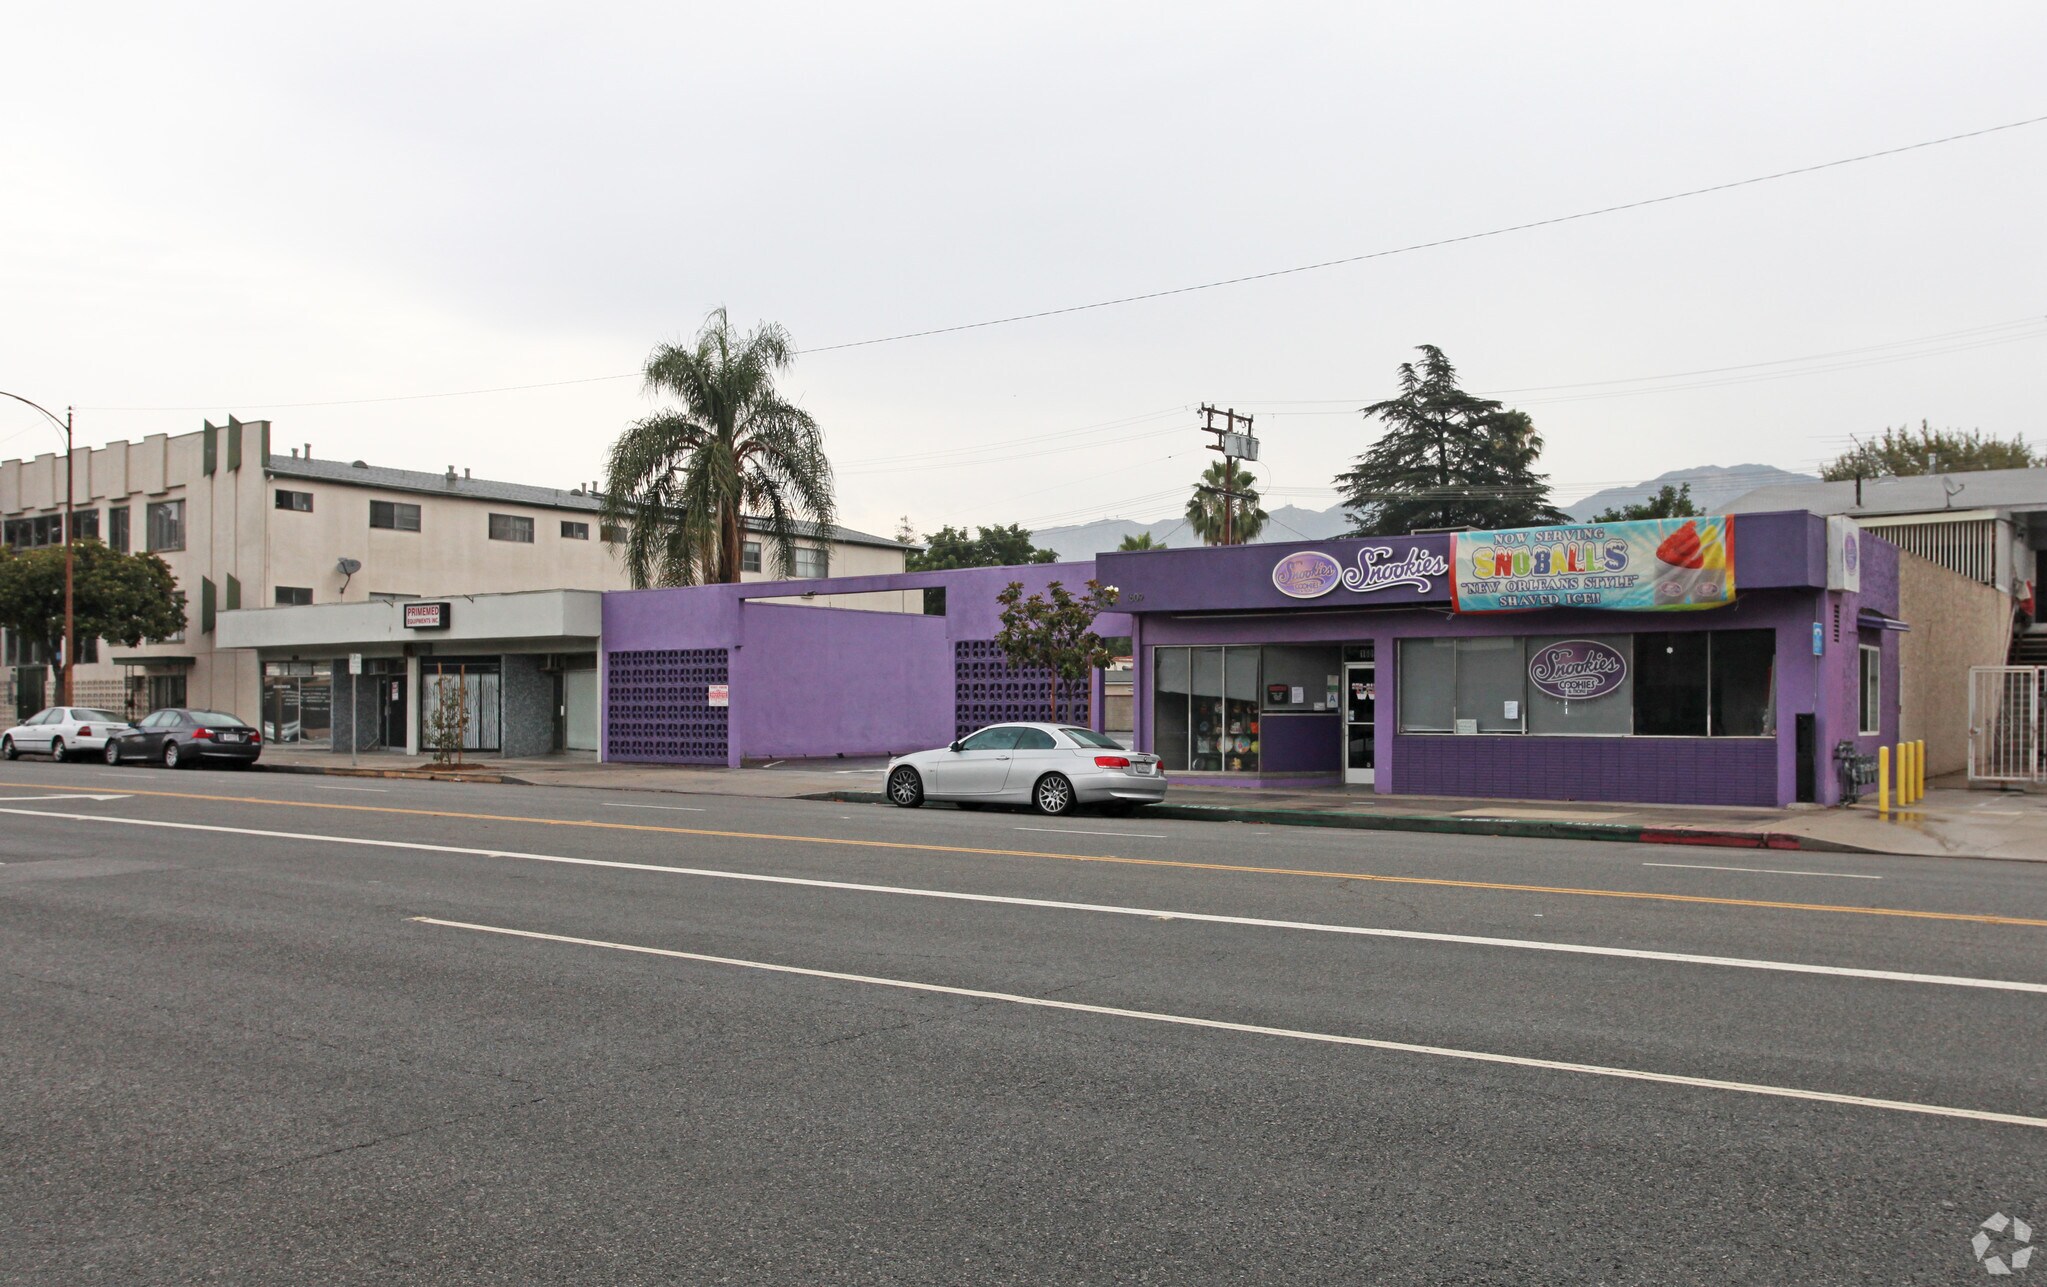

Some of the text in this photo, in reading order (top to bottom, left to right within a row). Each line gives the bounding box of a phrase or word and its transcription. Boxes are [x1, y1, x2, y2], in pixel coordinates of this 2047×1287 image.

[1494, 527, 1604, 545] NOW SERVING
[1277, 560, 1335, 586] Snookies
[1341, 546, 1449, 593] Snookies
[1505, 578, 1578, 592] ORLEANS
[1499, 593, 1601, 607] SHAVED ICE!!
[407, 606, 439, 616] PRIMEMED
[1533, 649, 1620, 684] Snookies
[1559, 680, 1595, 690] COOKIES
[1329, 695, 1336, 703] A
